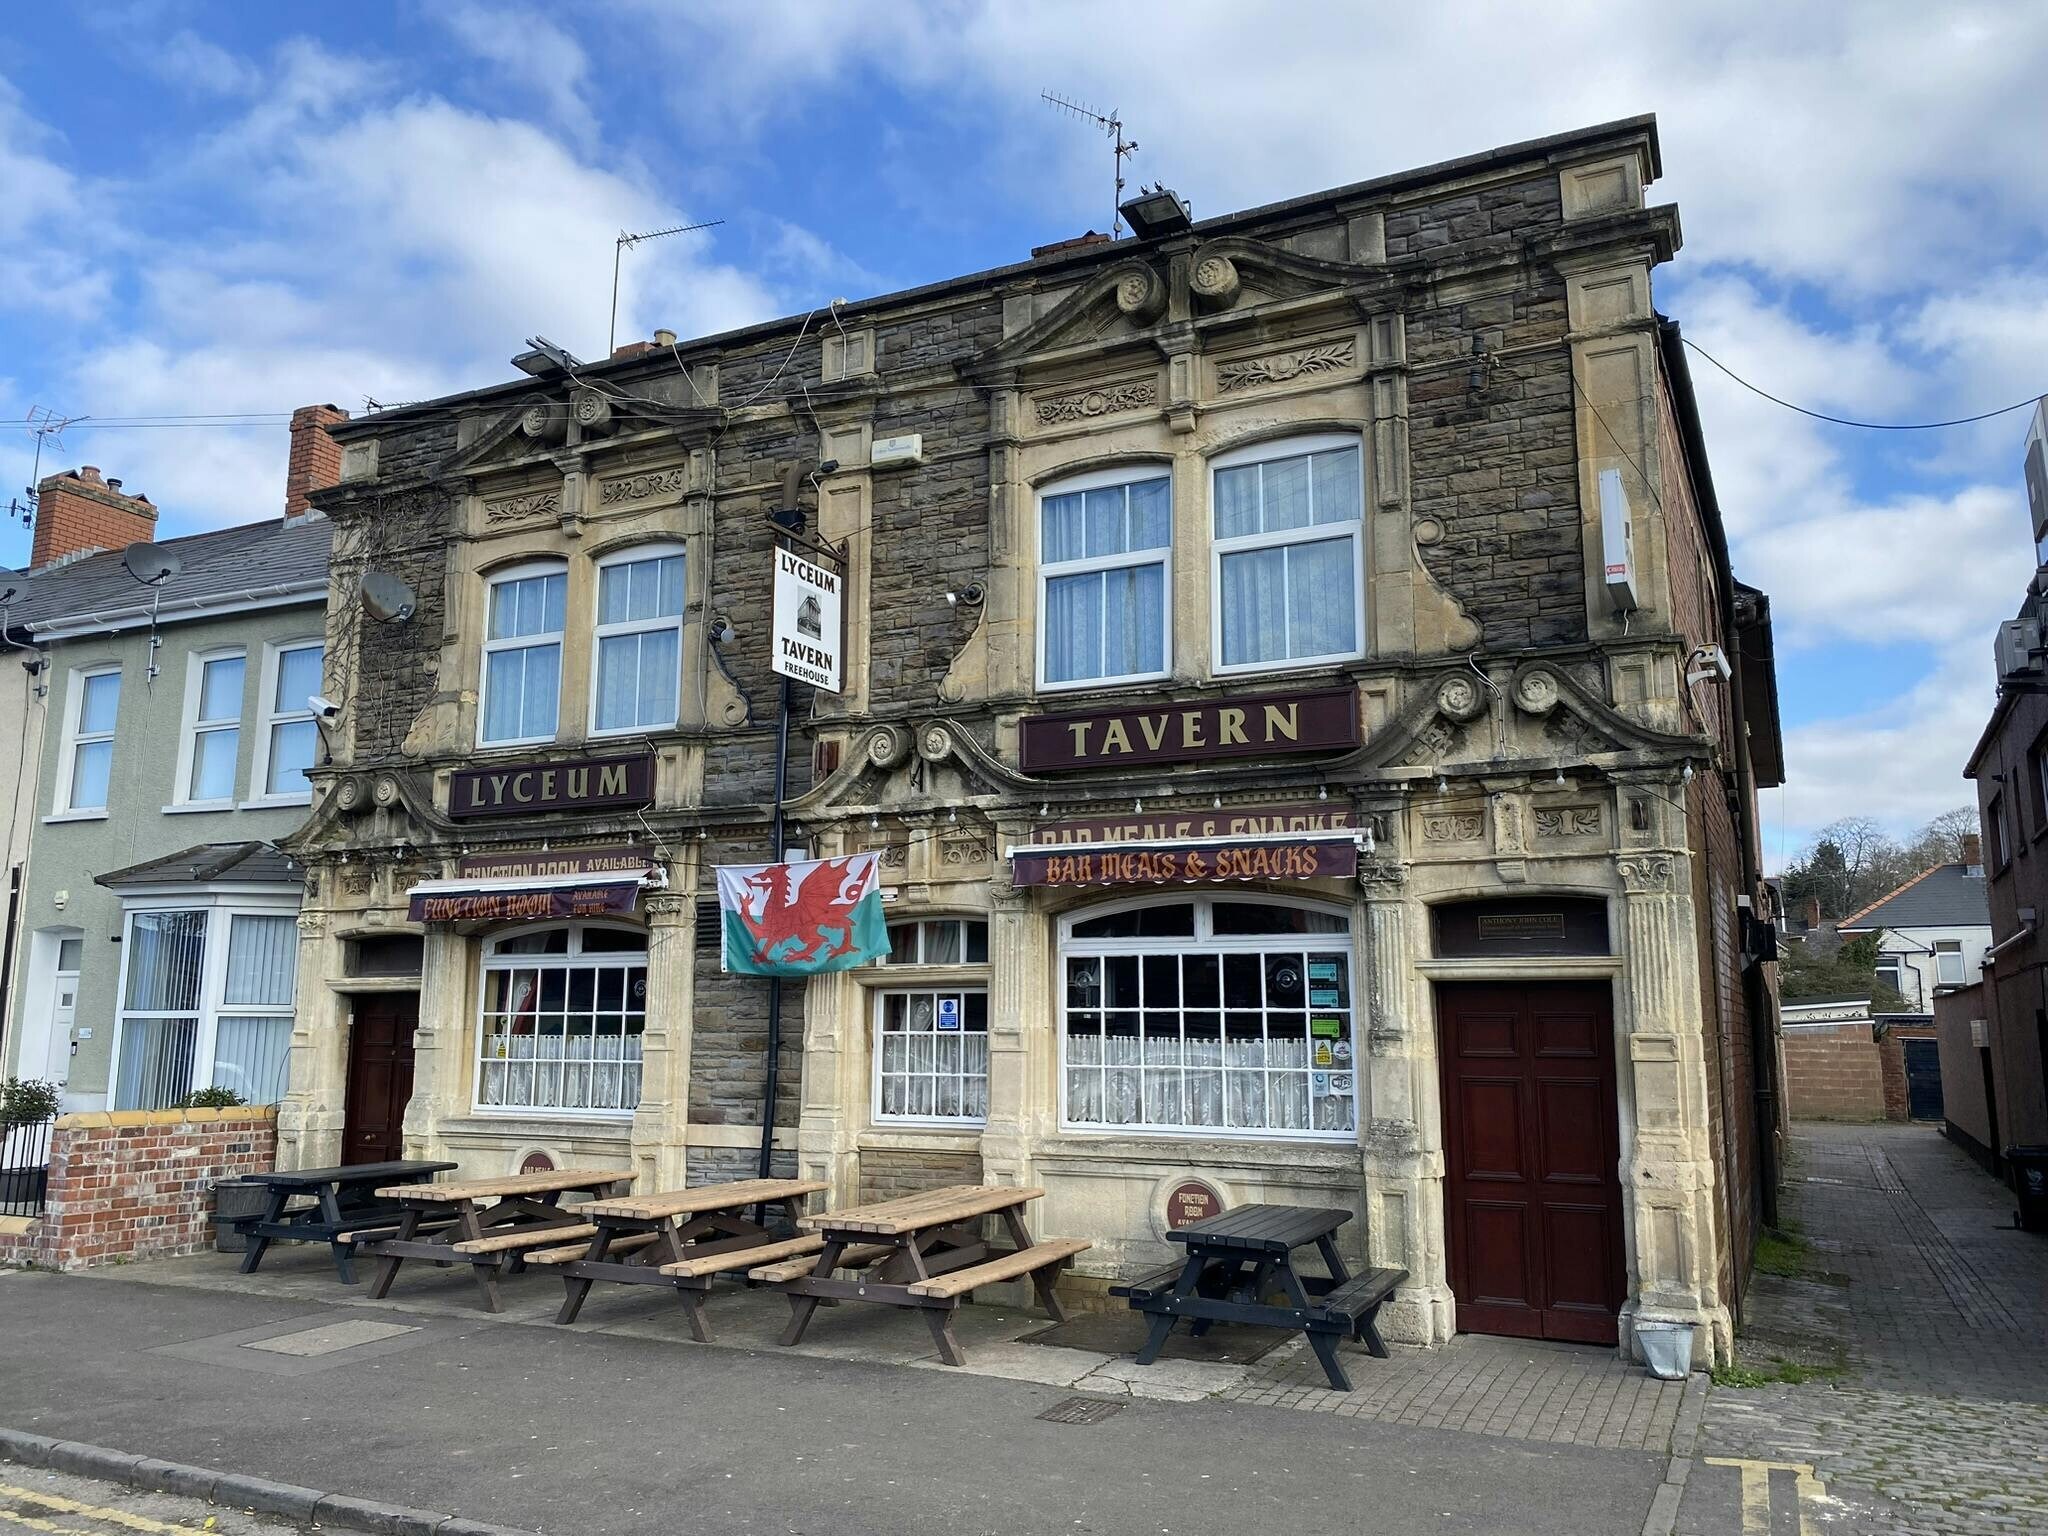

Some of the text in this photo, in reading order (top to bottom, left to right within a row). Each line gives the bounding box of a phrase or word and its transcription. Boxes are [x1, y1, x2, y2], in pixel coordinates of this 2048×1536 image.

[782, 554, 835, 594] LYCEUM
[782, 637, 833, 672] TAVERN
[784, 661, 829, 685] FREEHOUSE
[1067, 703, 1299, 757] TAVERN
[470, 763, 630, 807] LYCEUM
[1046, 845, 1318, 883] BAR MEALS & SNACKS
[423, 893, 553, 920] FUNCTION ROOM
[1178, 1193, 1209, 1205] FUNCTION
[1184, 1206, 1203, 1217] ROOM
